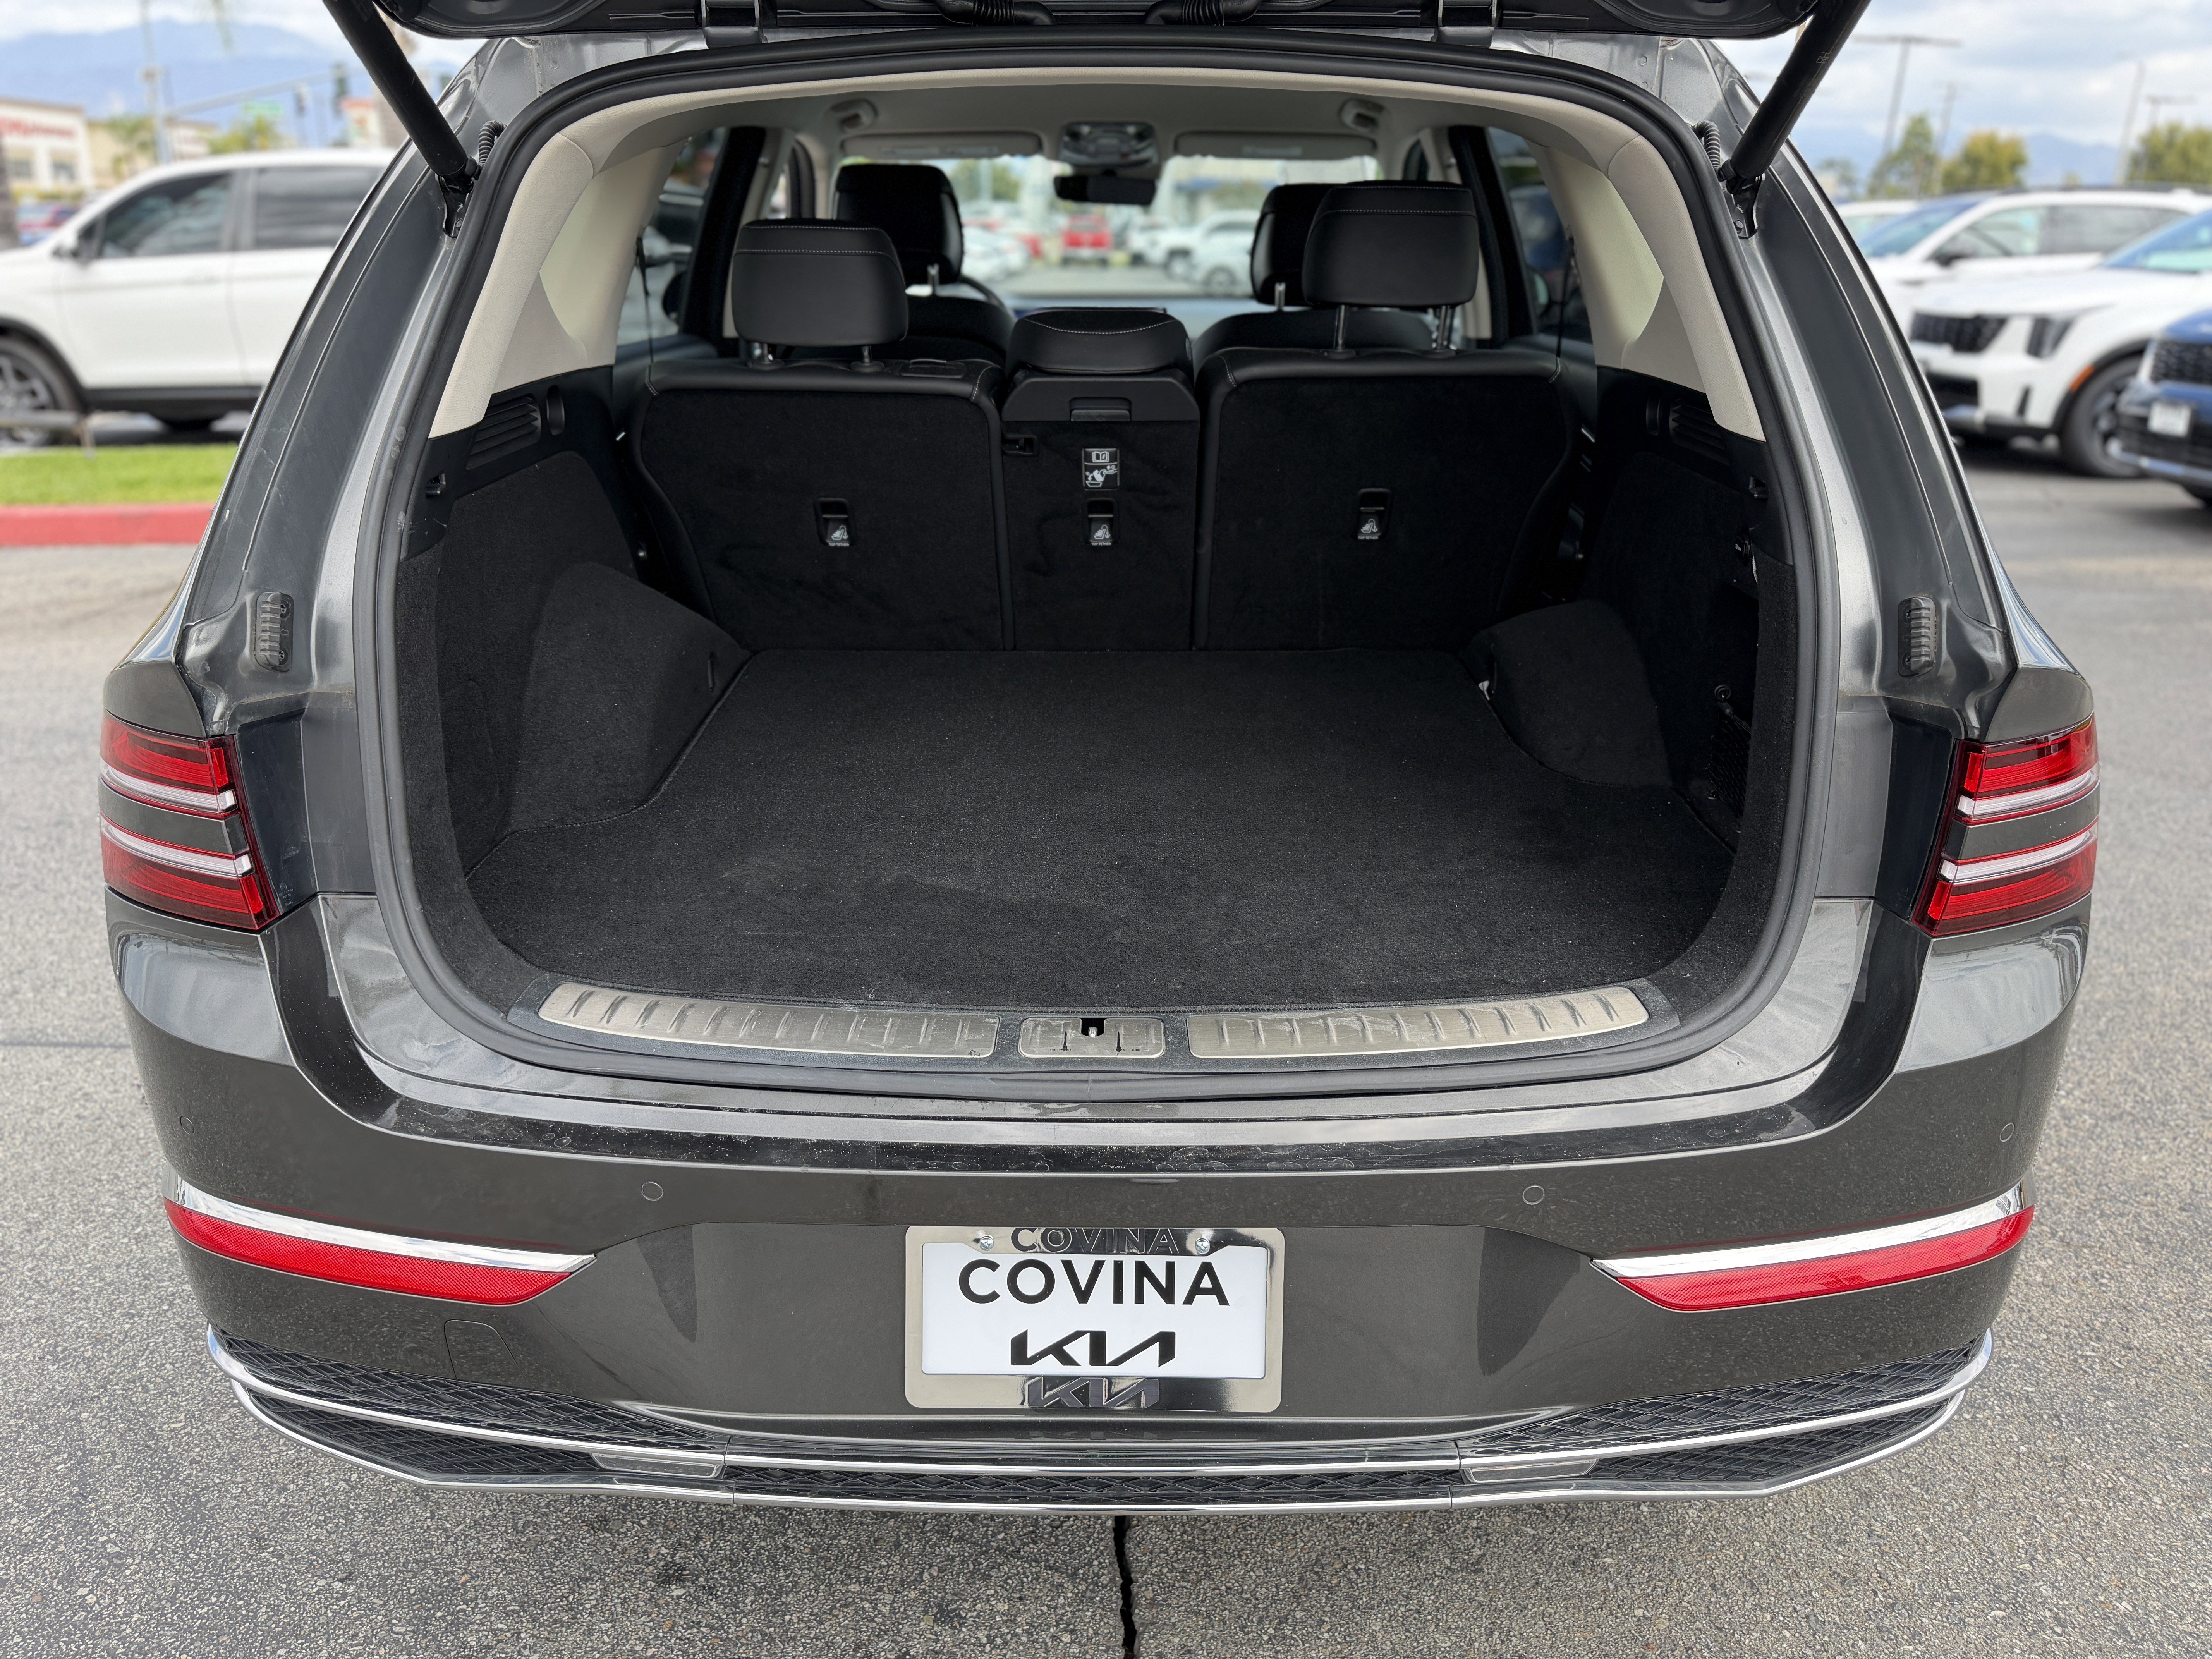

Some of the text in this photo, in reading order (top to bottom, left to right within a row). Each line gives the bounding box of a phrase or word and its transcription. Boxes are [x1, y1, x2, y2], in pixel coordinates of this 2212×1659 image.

[1011, 1228, 1179, 1254] COVINA
[958, 1258, 1230, 1306] COVINA
[1010, 1329, 1176, 1368] KIA
[1027, 1376, 1159, 1409] KIA
